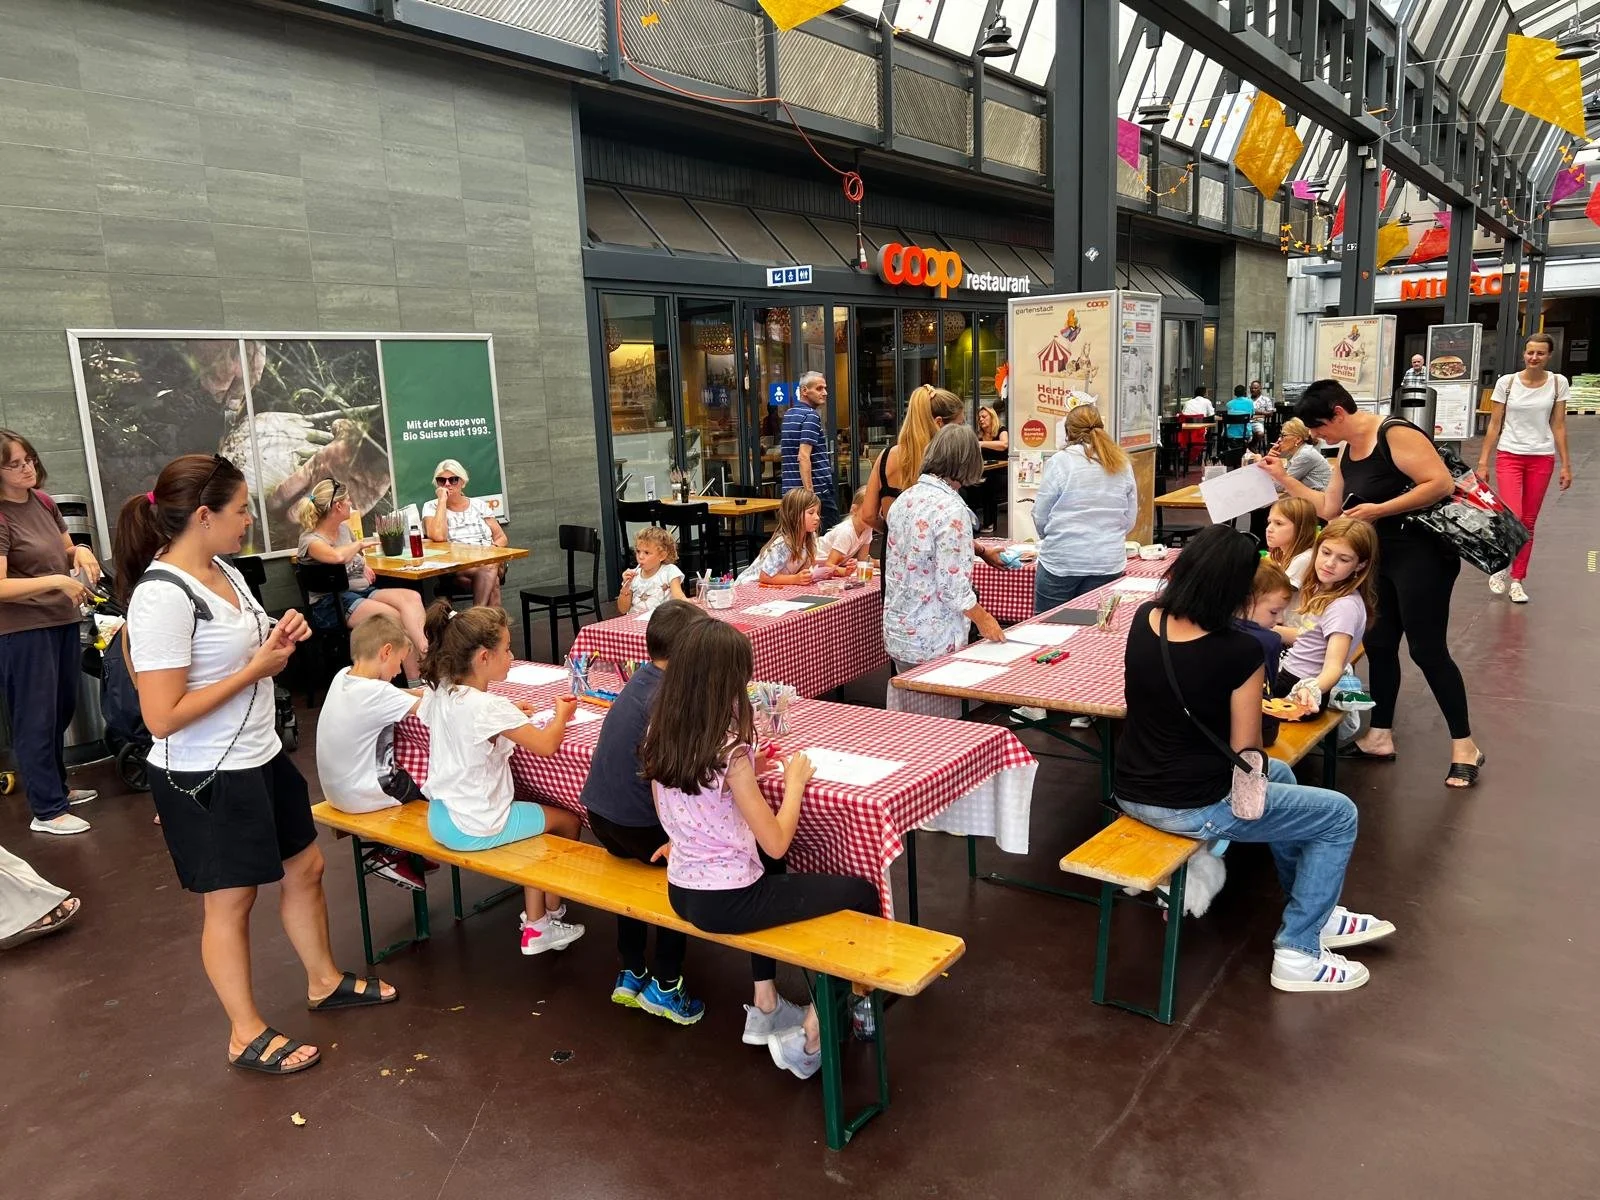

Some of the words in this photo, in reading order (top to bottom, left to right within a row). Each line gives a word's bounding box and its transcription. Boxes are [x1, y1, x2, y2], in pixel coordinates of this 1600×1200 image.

[877, 243, 963, 299] coop
[966, 272, 1030, 294] restaurant
[1086, 300, 1108, 308] coop
[1015, 305, 1054, 315] gartenstadt
[1331, 363, 1356, 371] Herbst
[406, 420, 421, 430] Mit
[422, 420, 437, 429] der
[438, 418, 470, 428] Knospe
[471, 417, 486, 425] von
[402, 431, 418, 441] Bio
[419, 430, 448, 440] Suisse
[449, 428, 465, 437] seit
[467, 426, 491, 436] 1993.
